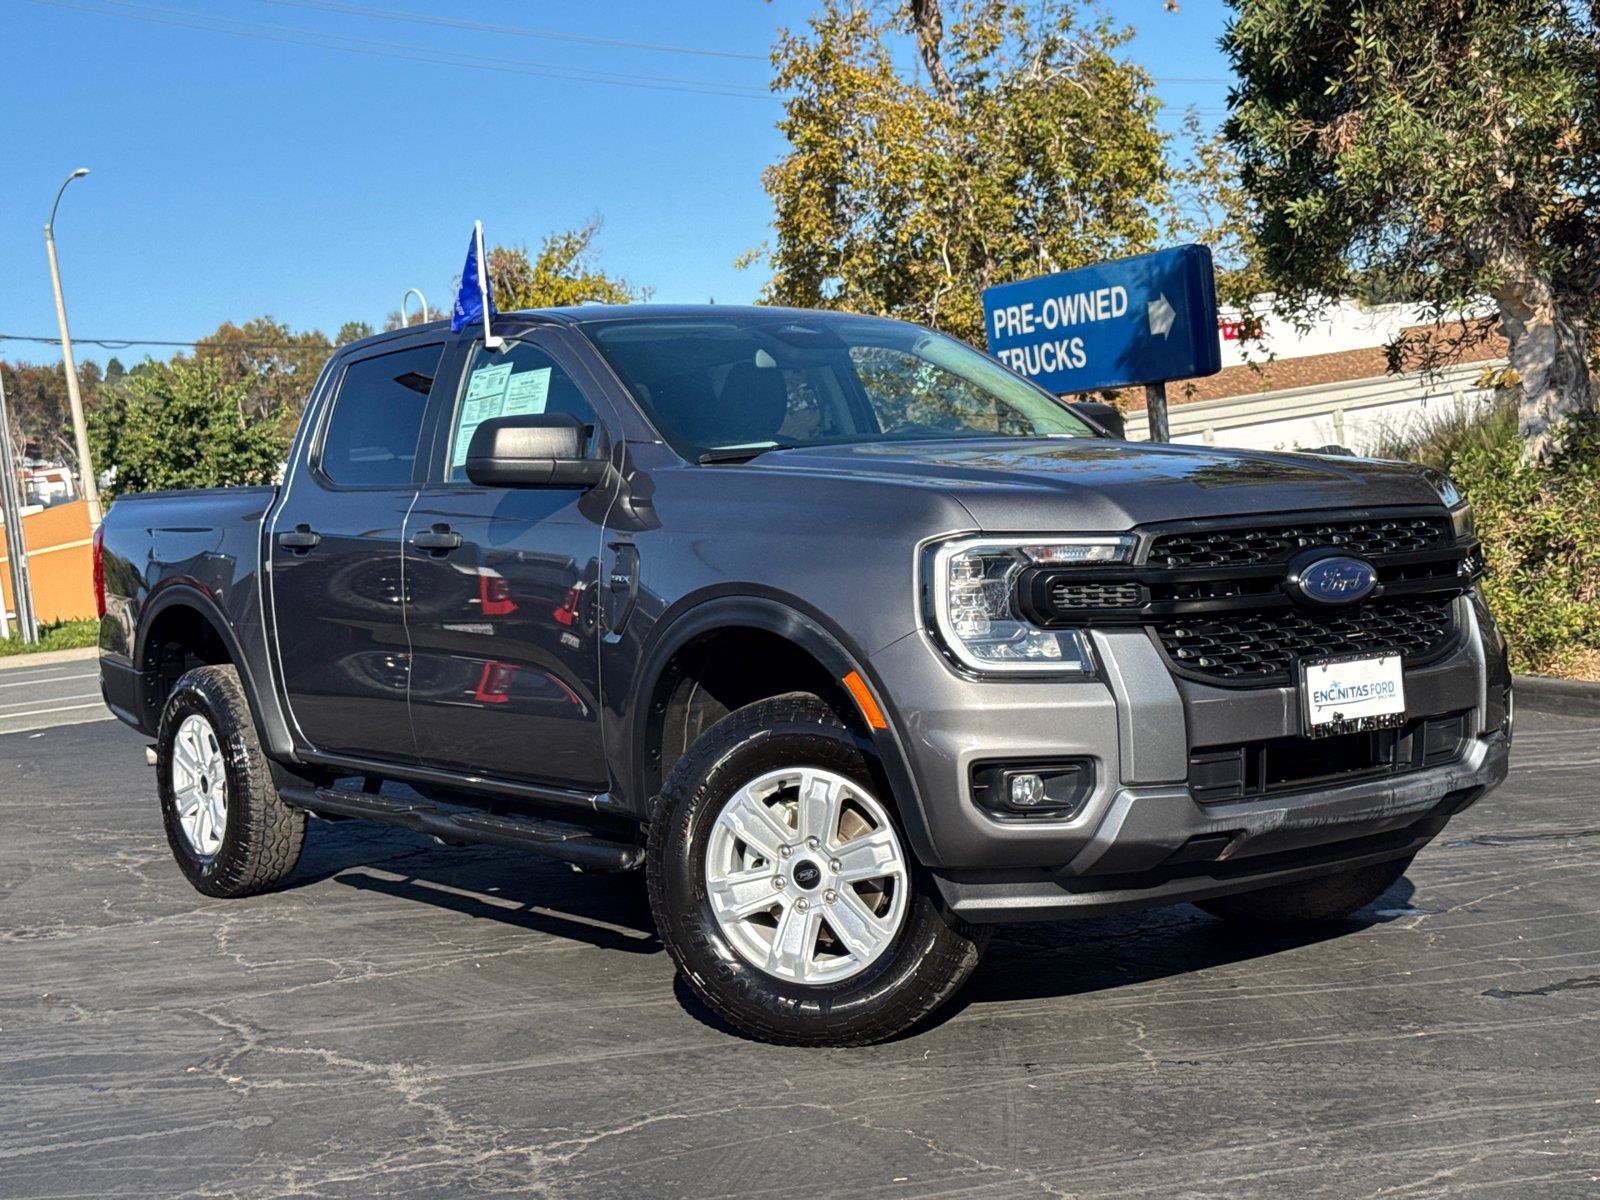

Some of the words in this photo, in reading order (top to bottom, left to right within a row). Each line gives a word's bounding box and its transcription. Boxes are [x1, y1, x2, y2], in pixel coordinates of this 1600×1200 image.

[993, 285, 1129, 339] PRE-OWNED
[997, 337, 1087, 377] TRUCKS
[1320, 568, 1362, 592] Ford
[1370, 681, 1395, 696] FORD
